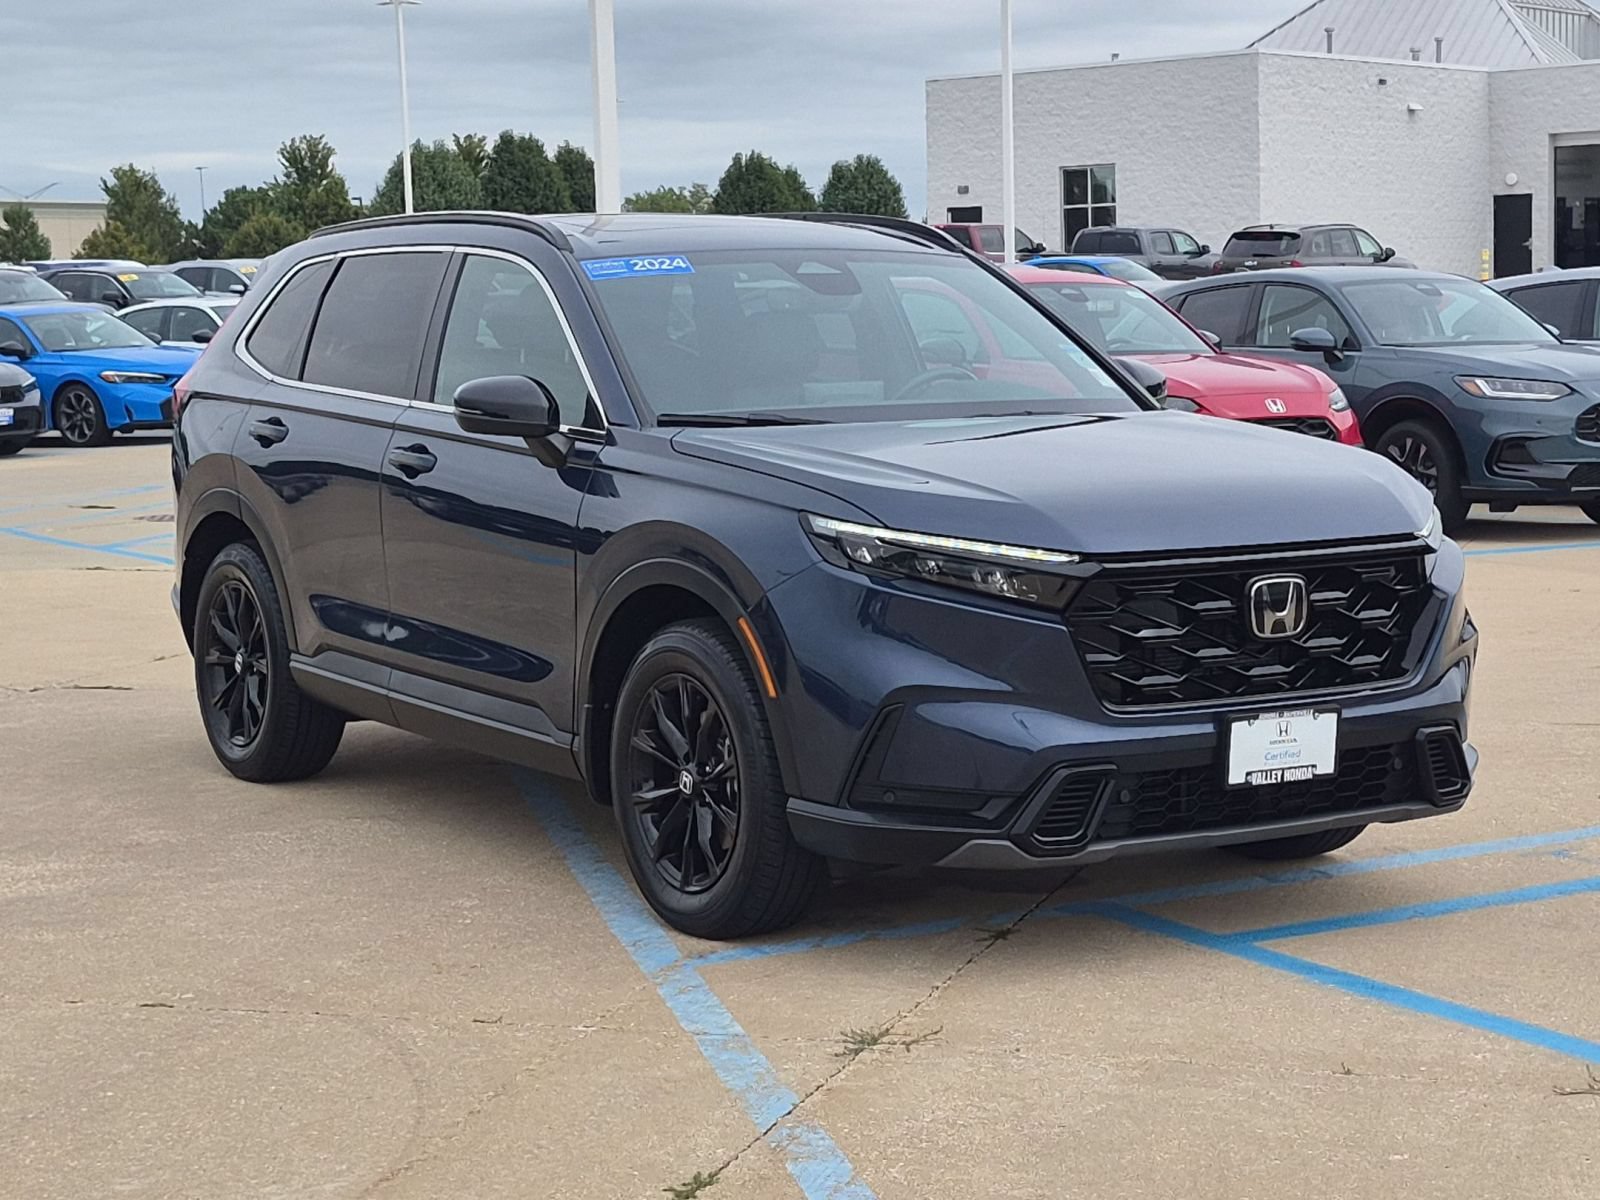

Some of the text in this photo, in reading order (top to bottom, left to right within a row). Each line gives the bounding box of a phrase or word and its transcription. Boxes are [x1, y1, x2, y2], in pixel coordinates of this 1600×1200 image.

[629, 258, 687, 271] 2024
[1264, 749, 1302, 761] Certified
[1251, 766, 1313, 785] VALLEY HONDA
